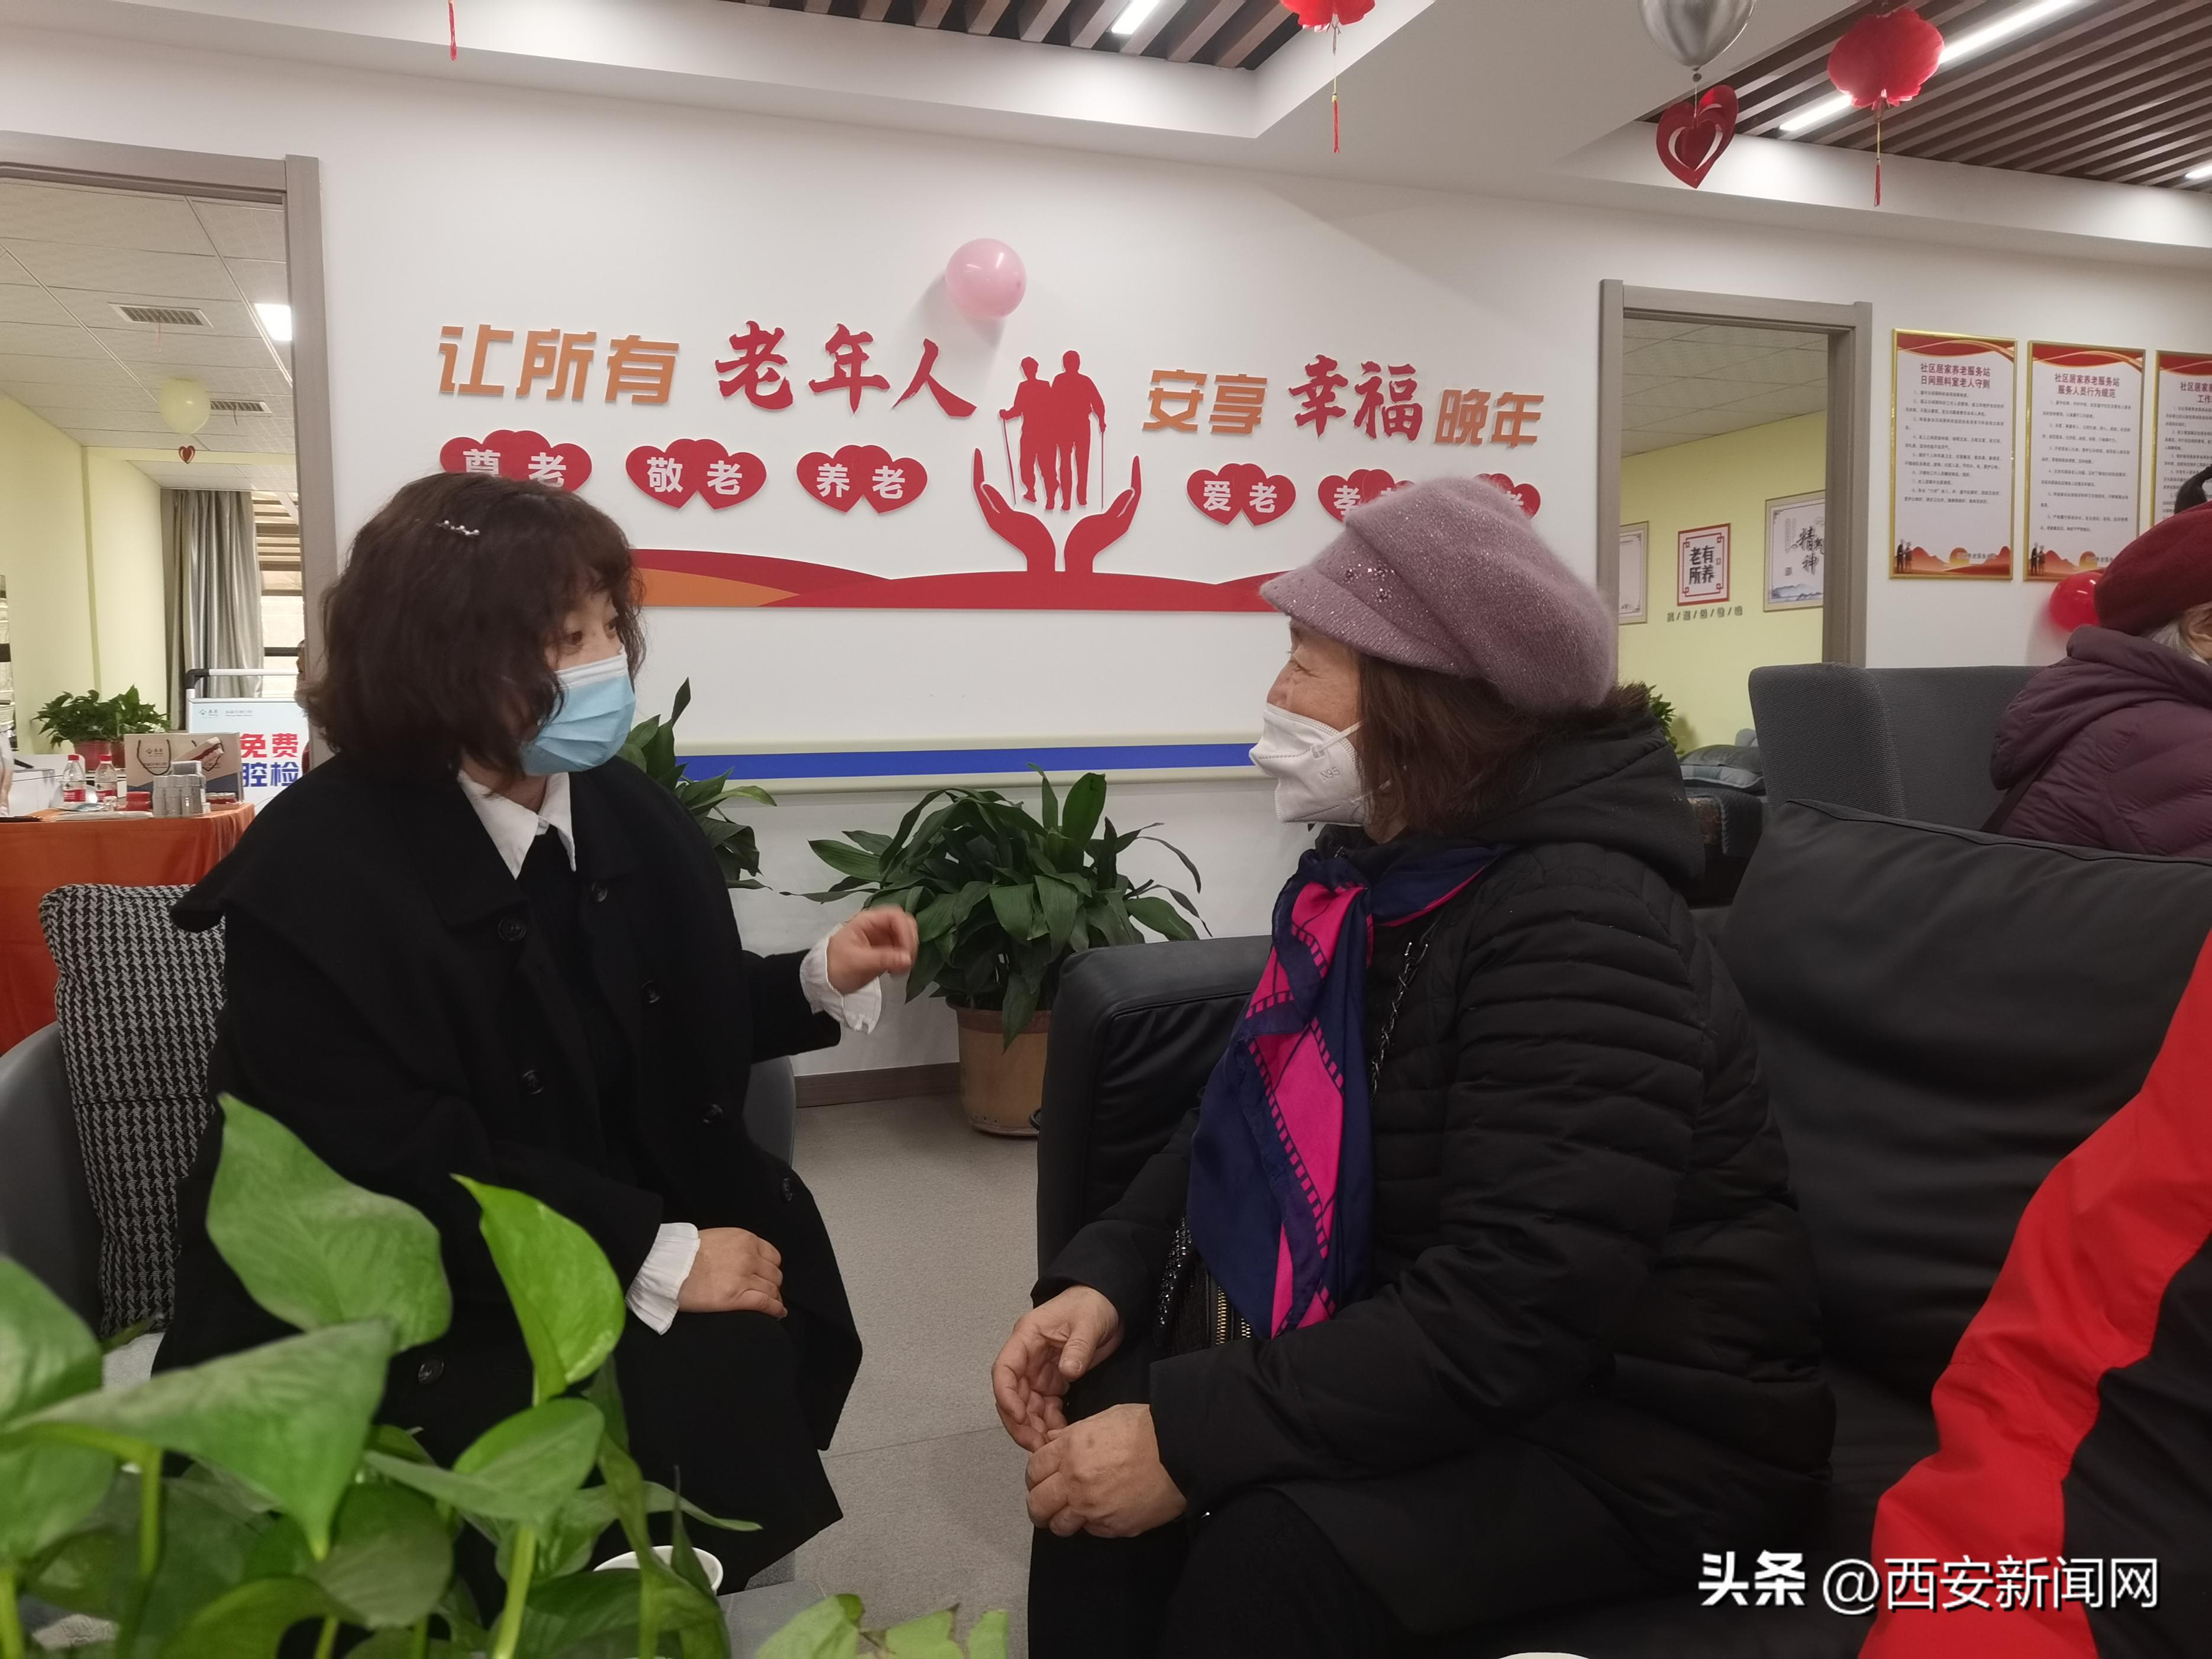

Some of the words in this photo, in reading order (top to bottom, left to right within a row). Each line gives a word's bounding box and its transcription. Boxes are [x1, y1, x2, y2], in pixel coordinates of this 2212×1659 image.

[439, 324, 679, 405] 让所有
[714, 320, 977, 418] 老年人
[1920, 363, 1990, 377] 社区居家养老服务站
[2055, 373, 2120, 386] 社区居家养老服务站
[1142, 369, 1267, 434] 安享
[1288, 354, 1423, 441] 幸福
[1434, 388, 1544, 448] 晚年
[2058, 385, 2116, 398] 服务人员行为规范
[646, 457, 742, 495] 敬老
[816, 463, 906, 499] 养老
[1203, 480, 1277, 514] 爱老
[240, 733, 298, 758] 免费
[1319, 766, 1341, 781] N95
